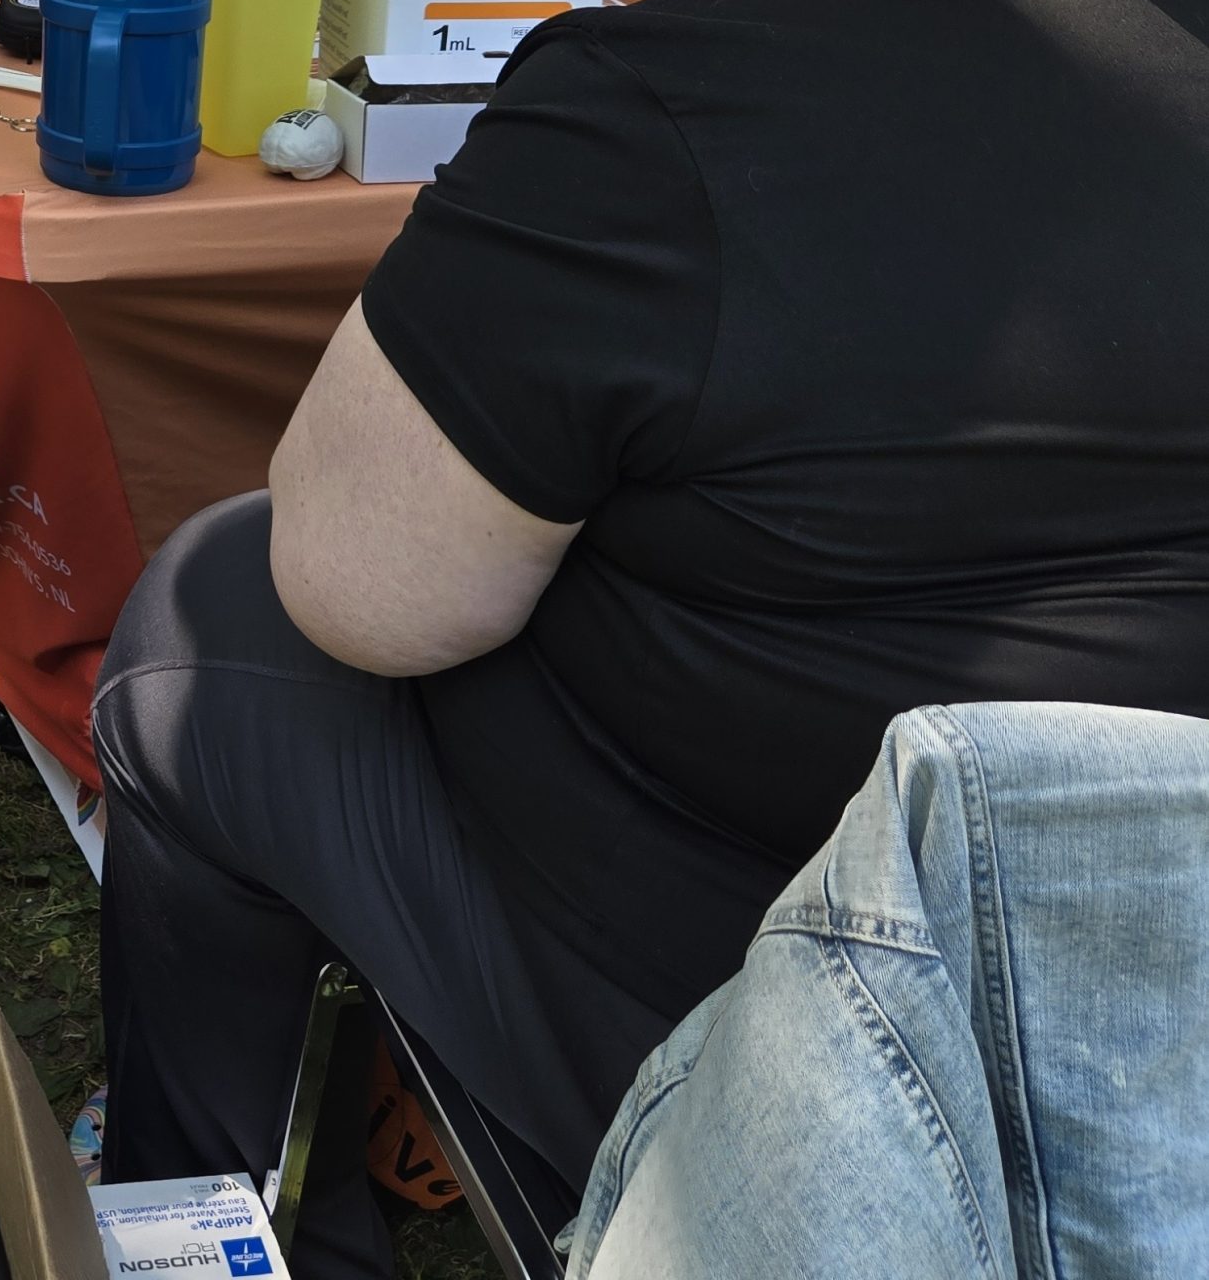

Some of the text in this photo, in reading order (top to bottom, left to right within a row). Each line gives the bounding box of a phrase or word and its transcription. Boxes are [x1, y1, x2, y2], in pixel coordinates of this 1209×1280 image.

[50, 584, 76, 613] NL
[212, 1181, 240, 1193] 100
[96, 1197, 247, 1219] Eau stérile pour inhalation, USP
[188, 1208, 216, 1219] Water
[218, 1205, 250, 1216] Sterile
[116, 1212, 169, 1225] Inhalation,
[173, 1210, 185, 1221] for
[119, 1253, 221, 1273] HUDSON
